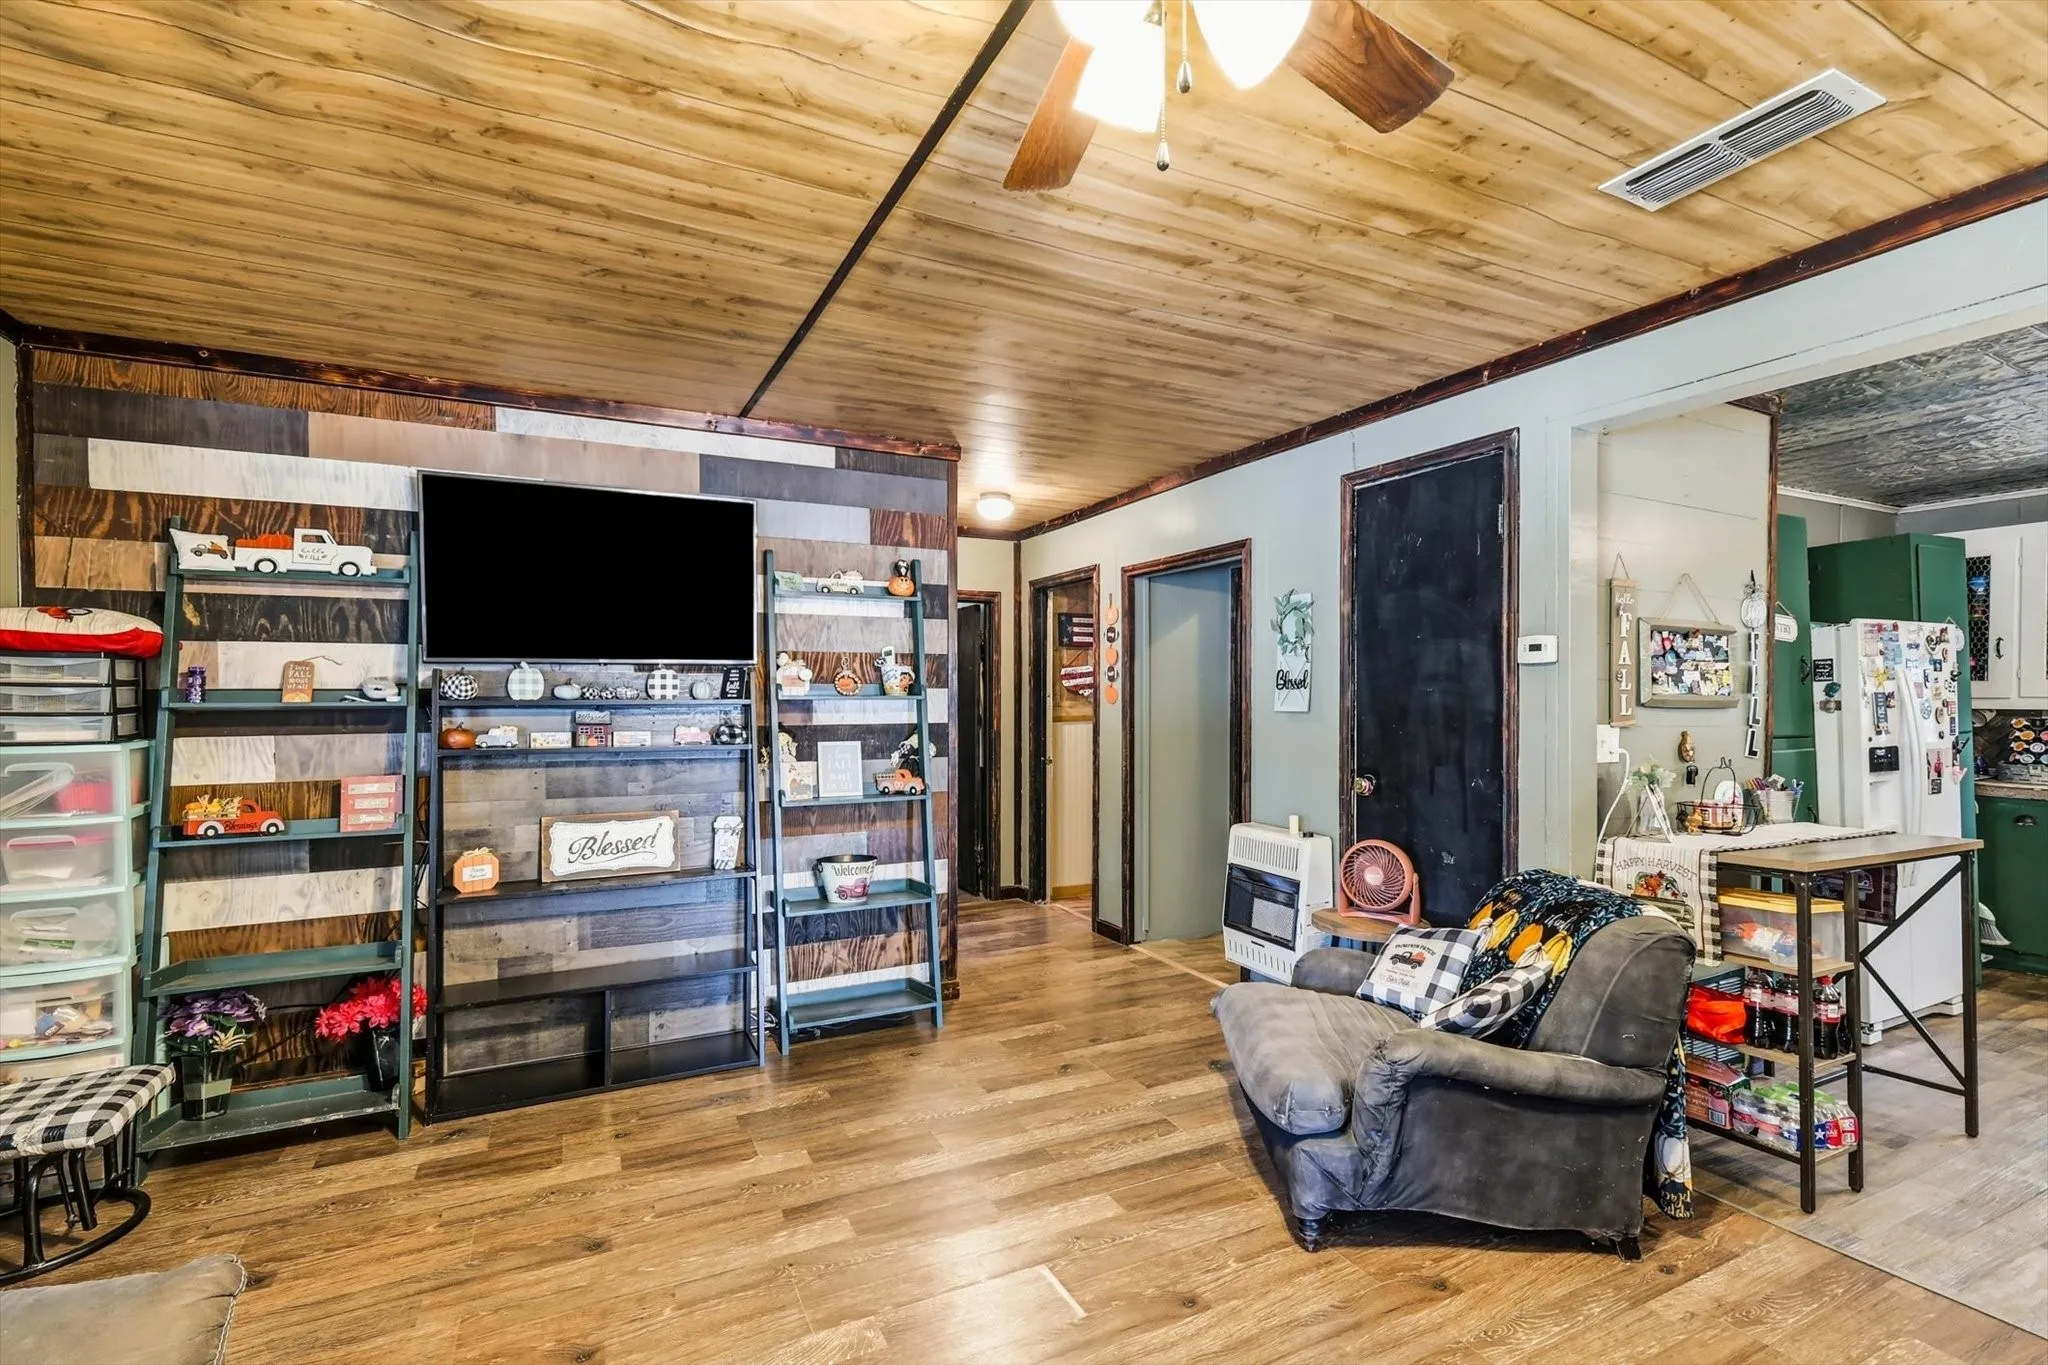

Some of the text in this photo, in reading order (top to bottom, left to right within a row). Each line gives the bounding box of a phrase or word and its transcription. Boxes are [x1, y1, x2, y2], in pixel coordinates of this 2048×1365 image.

[288, 670, 312, 678] FALL
[1619, 612, 1632, 716] FALL
[1275, 668, 1310, 691] Blessed
[567, 822, 663, 864] Blessed
[1614, 856, 1698, 883] HAPPY HARVEST
